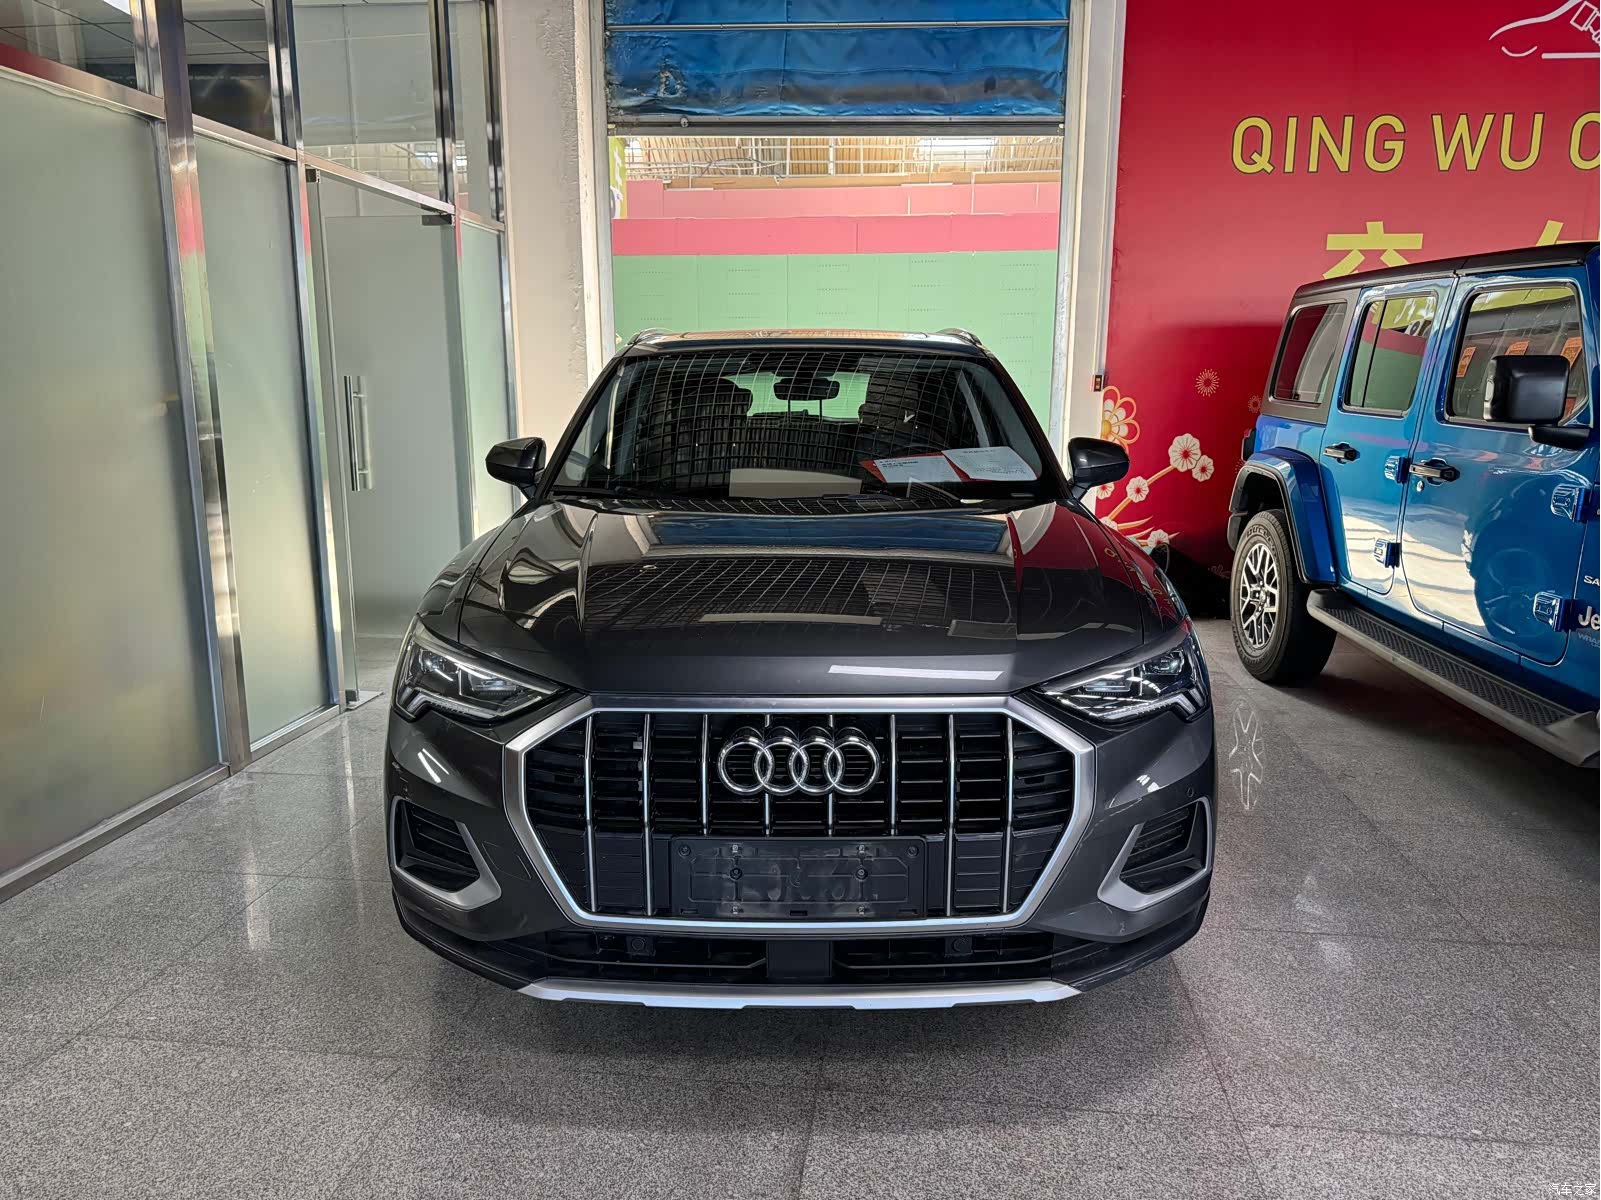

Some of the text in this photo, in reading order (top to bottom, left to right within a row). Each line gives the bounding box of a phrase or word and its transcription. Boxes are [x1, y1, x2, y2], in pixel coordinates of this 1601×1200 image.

[1231, 114, 1406, 174] QING
[1431, 112, 1545, 172] WU
[1578, 605, 1600, 631] Je
